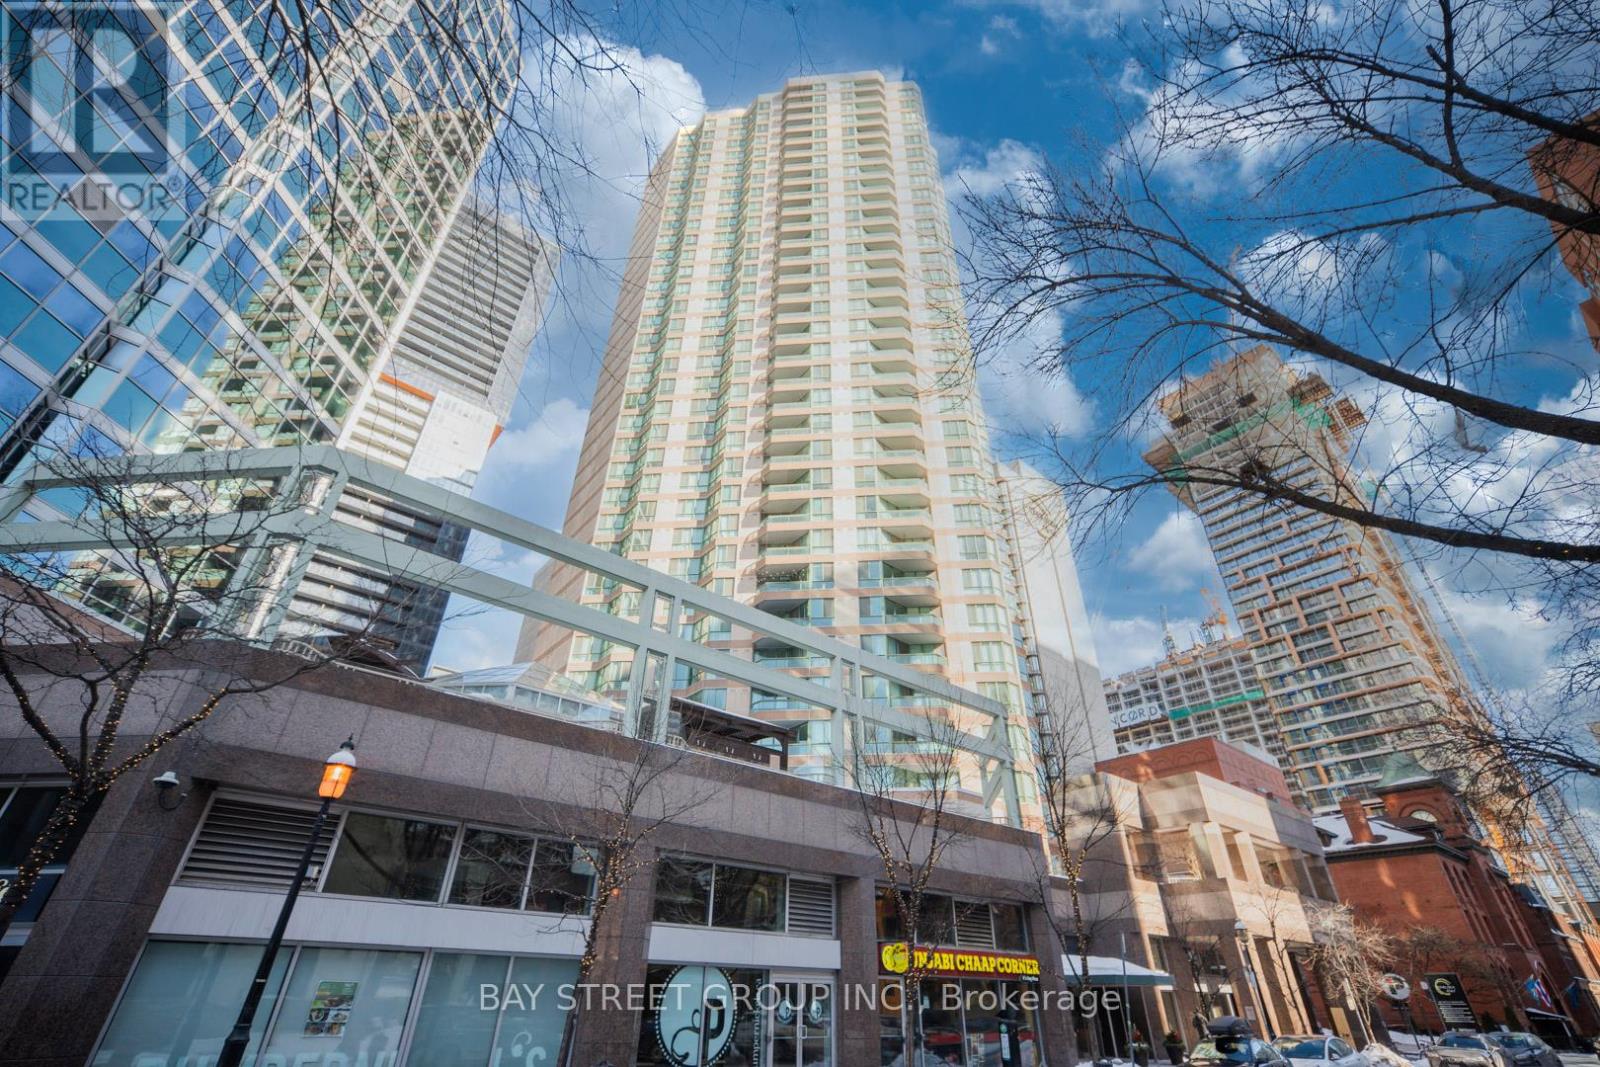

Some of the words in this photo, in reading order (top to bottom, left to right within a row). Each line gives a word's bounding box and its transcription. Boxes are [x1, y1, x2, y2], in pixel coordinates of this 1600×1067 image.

[913, 951, 955, 970] NJABI
[956, 954, 996, 973] CHAAP
[996, 957, 1041, 975] CORNER
